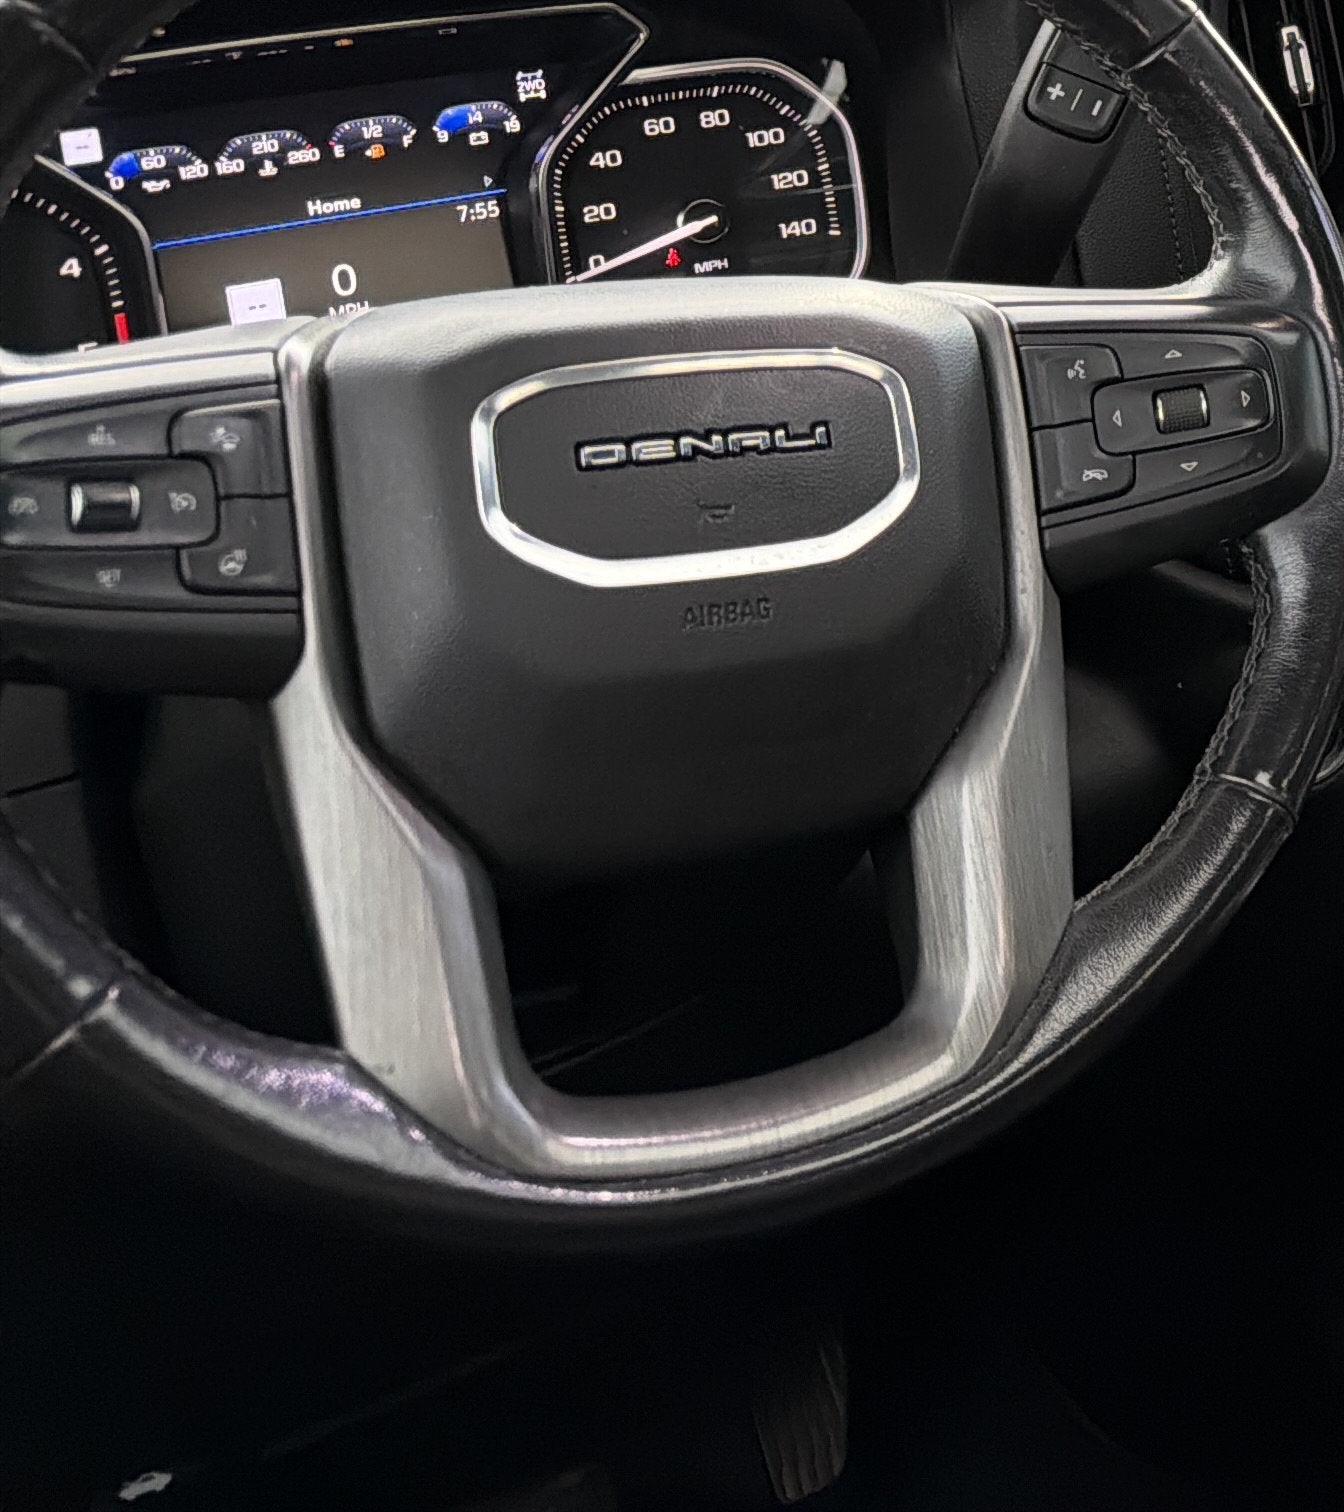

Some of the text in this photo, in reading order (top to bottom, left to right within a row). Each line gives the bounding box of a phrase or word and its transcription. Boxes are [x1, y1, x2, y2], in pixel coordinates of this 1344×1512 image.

[516, 79, 546, 93] 2WD
[503, 120, 521, 133] 19
[642, 116, 676, 136] 60
[699, 107, 731, 129] 80
[252, 138, 280, 155] 210
[401, 134, 413, 148] F
[744, 126, 786, 148] 100
[286, 148, 321, 165] 260
[333, 144, 346, 158] E
[588, 148, 623, 169] 40
[178, 163, 209, 181] 120
[215, 159, 245, 176] 160
[769, 168, 809, 190] 120
[306, 196, 362, 217] Home
[455, 200, 500, 223] 7:55
[582, 202, 617, 224] 20
[777, 217, 817, 239] 140
[58, 256, 83, 279] 4
[693, 257, 729, 275] MPH
[331, 262, 358, 297] 0
[577, 423, 830, 471] DENALI
[681, 597, 774, 632] AIRBAG
